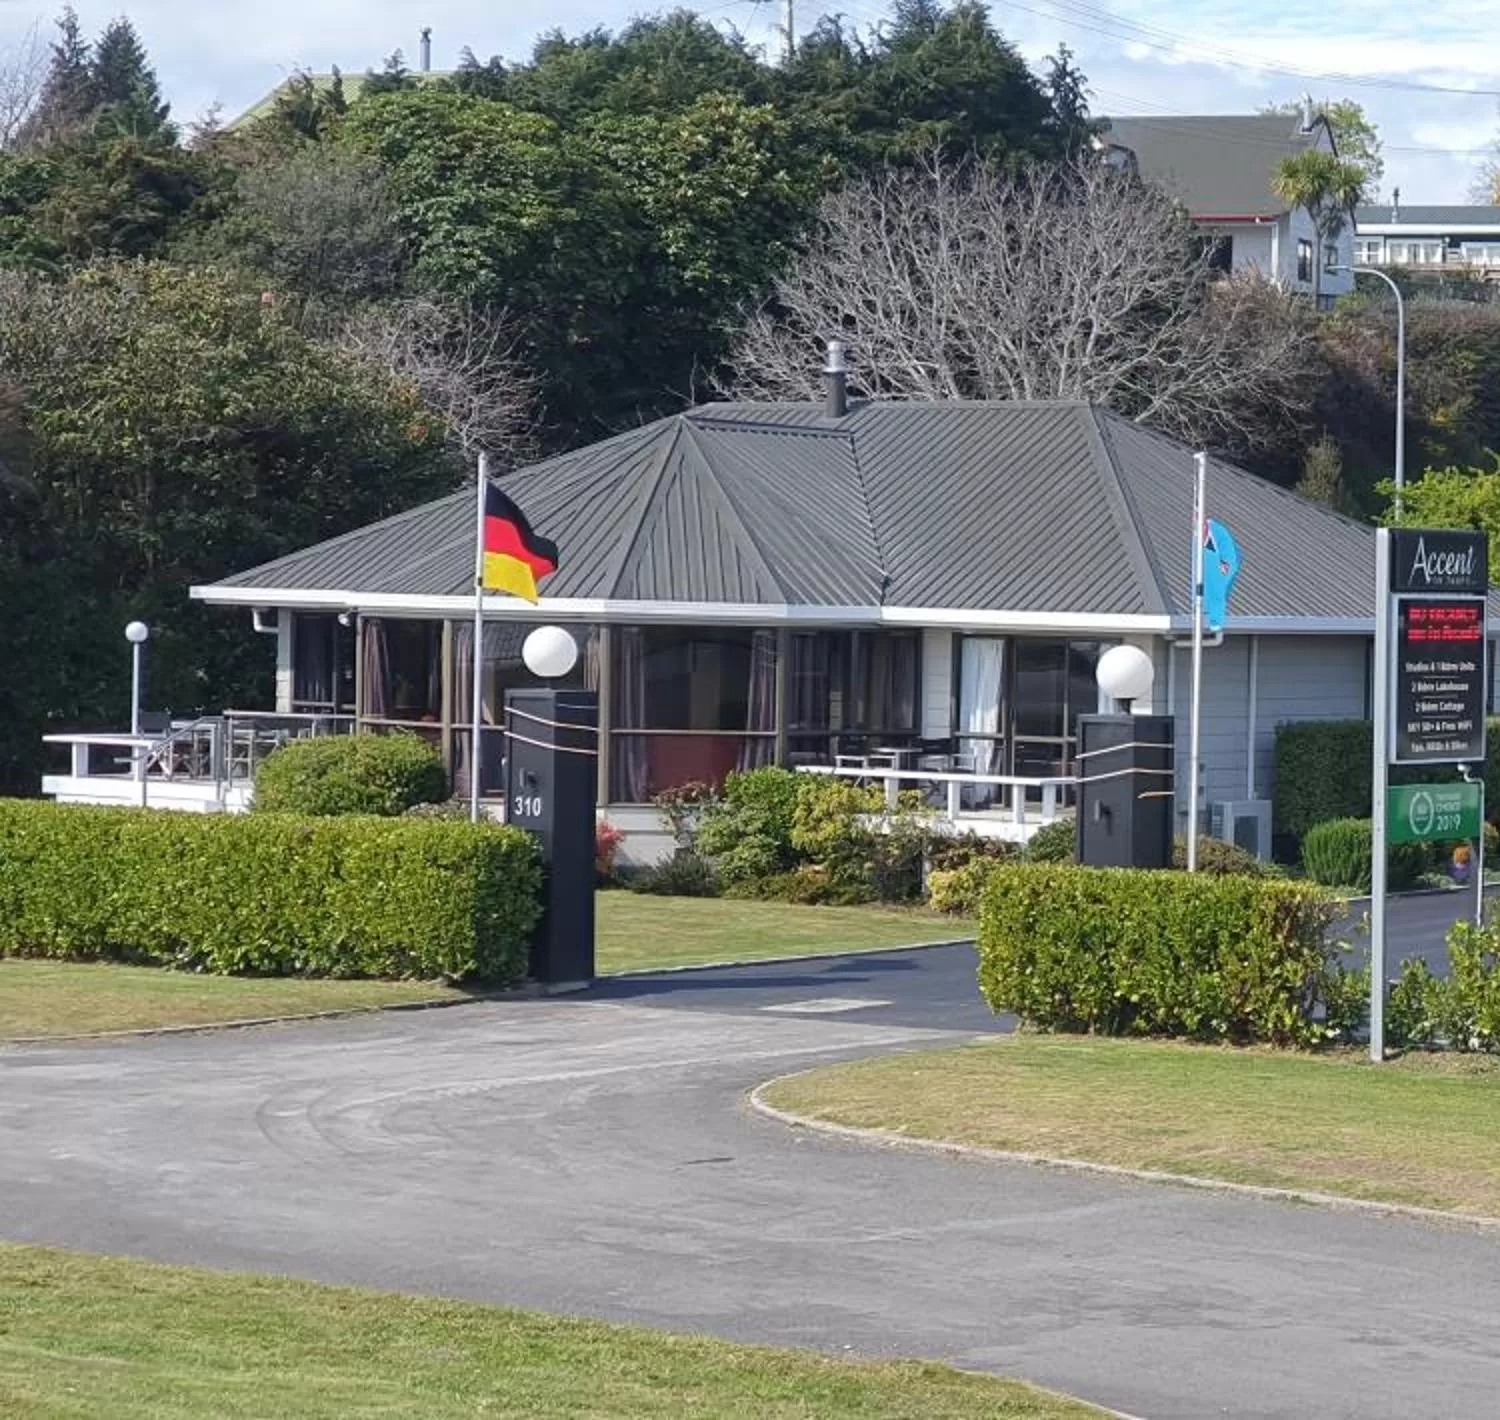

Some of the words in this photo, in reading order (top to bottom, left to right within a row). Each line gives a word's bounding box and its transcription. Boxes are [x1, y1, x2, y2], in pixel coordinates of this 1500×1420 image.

[1408, 536, 1476, 585] Accent
[1440, 701, 1465, 712] Cottage
[514, 796, 542, 817] 310
[1436, 814, 1461, 831] 2019
